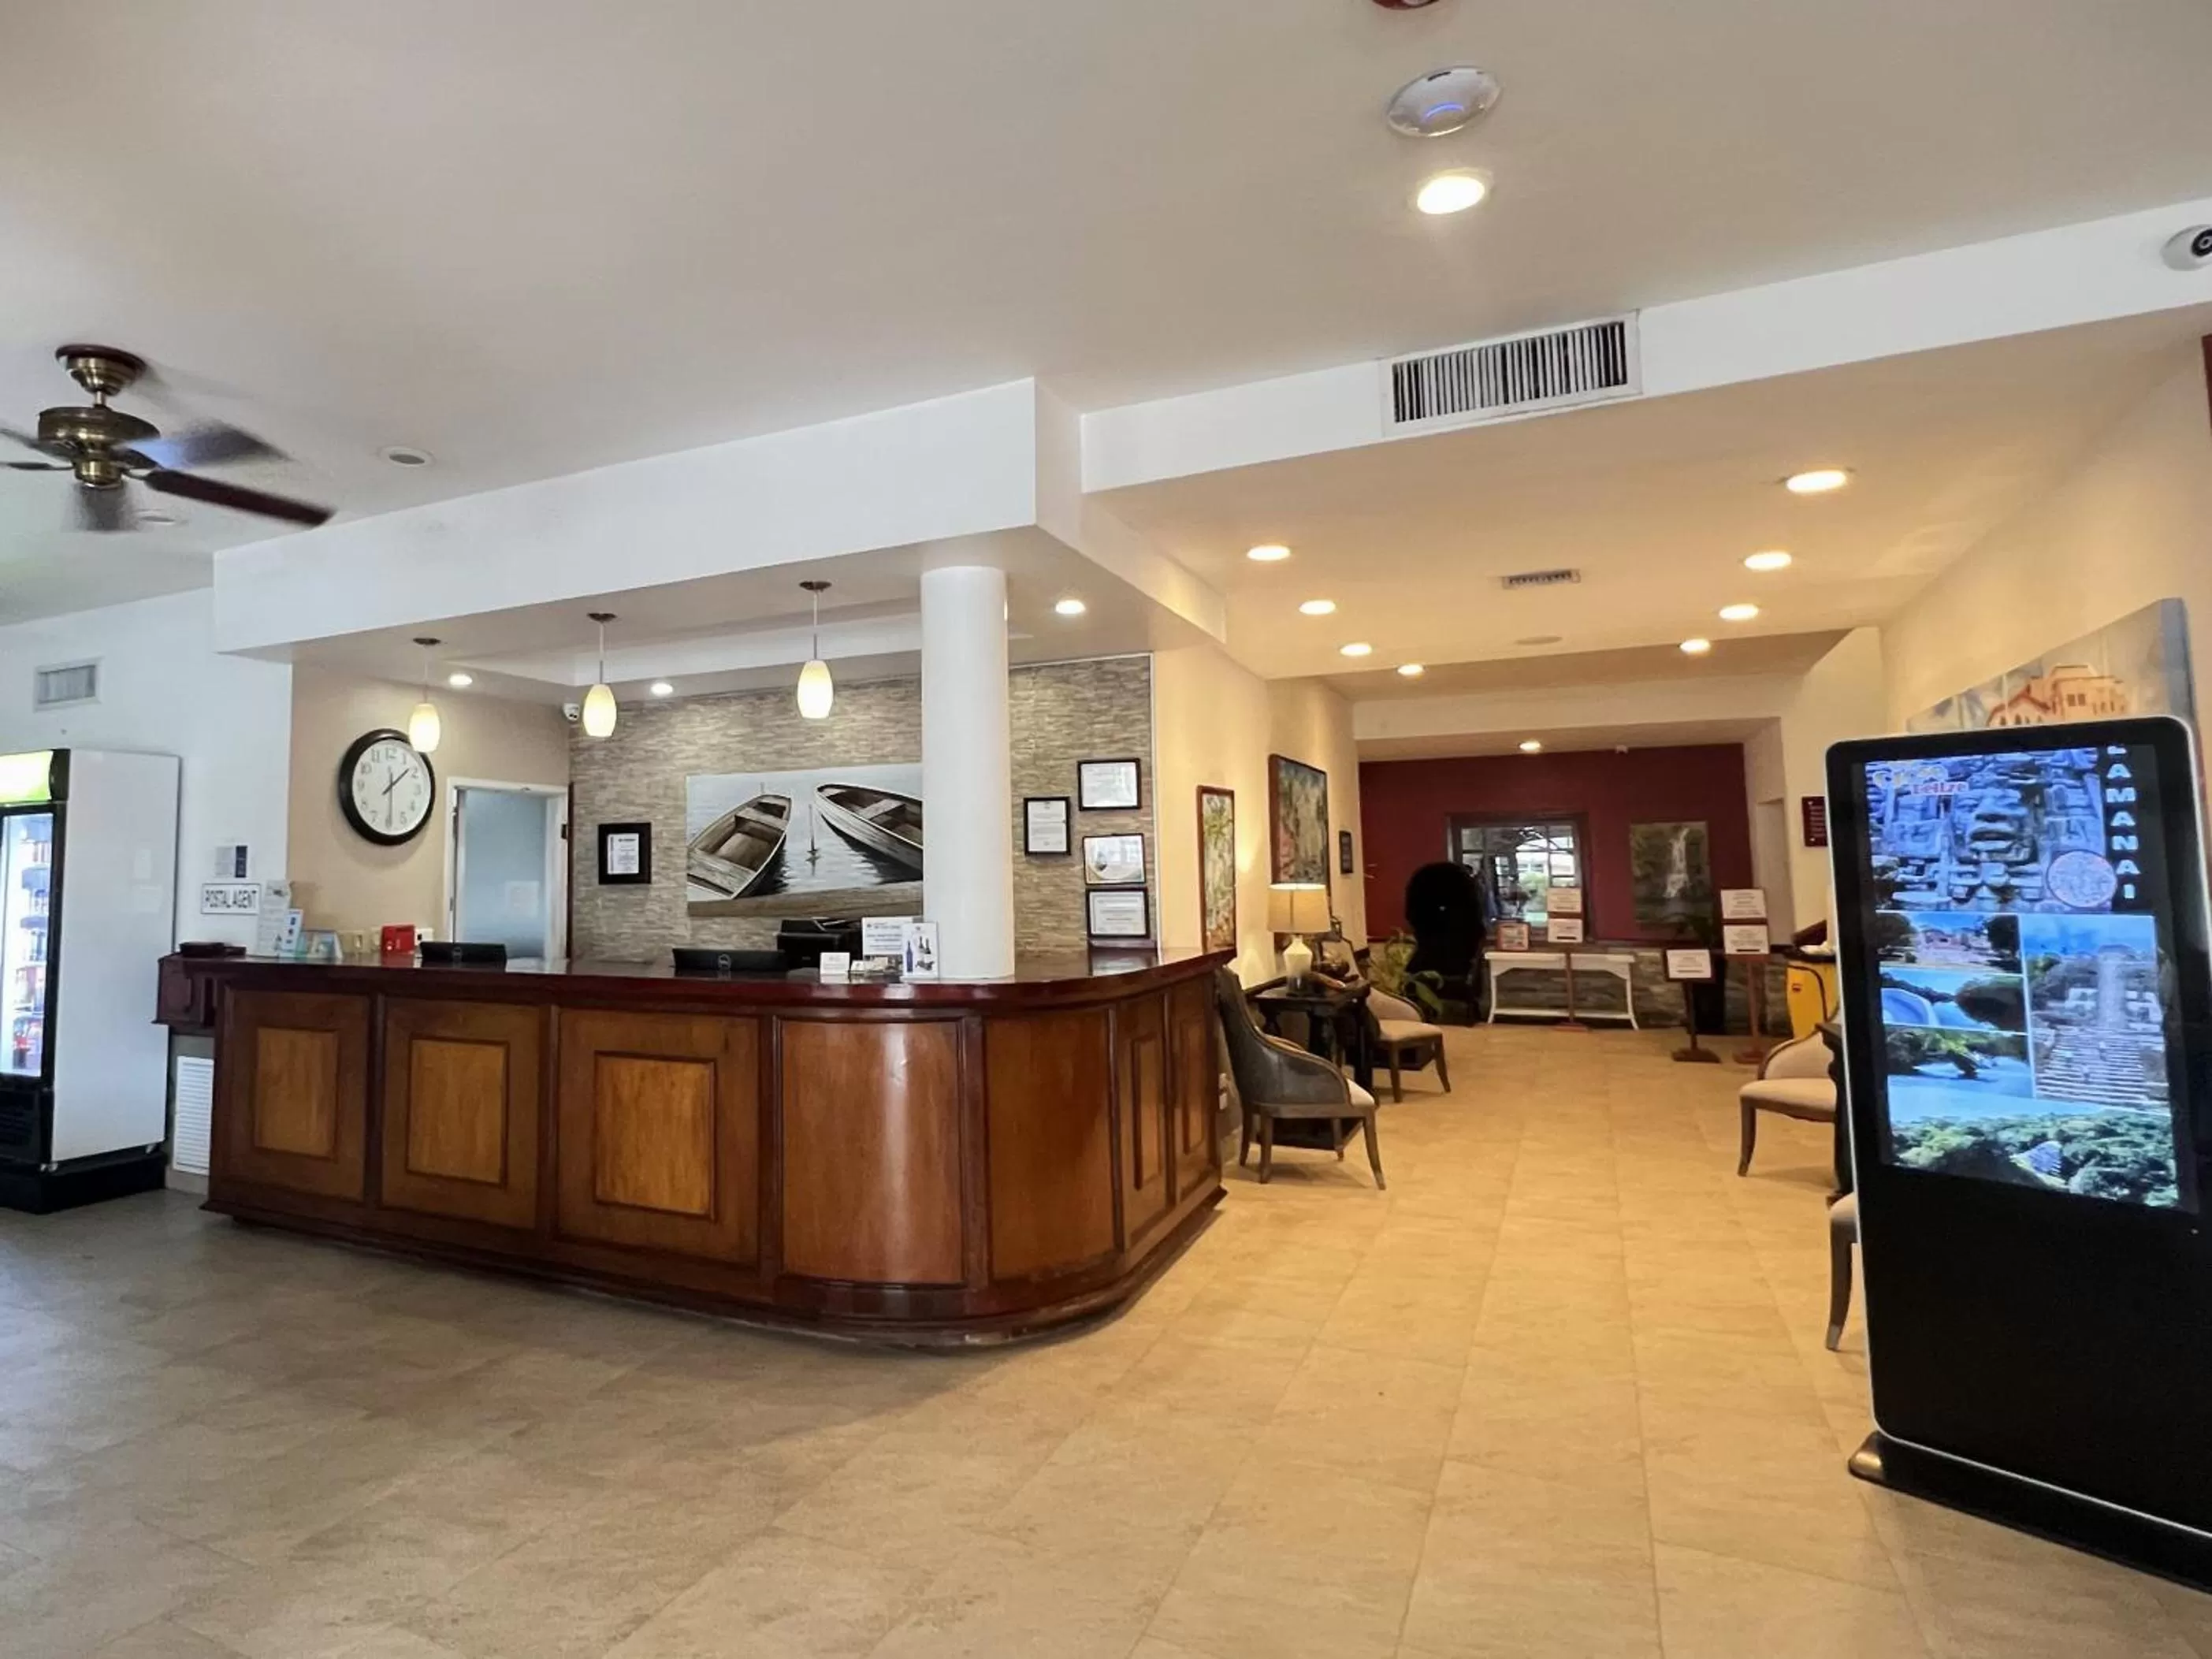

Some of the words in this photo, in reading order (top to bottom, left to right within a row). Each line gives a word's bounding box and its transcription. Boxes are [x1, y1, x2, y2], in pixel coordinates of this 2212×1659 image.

[371, 748, 380, 764] 11
[385, 746, 398, 761] 12
[402, 753, 407, 765] 1
[360, 761, 373, 776] 10
[411, 766, 419, 779] 2
[356, 779, 365, 792] 9
[413, 784, 422, 797] 3
[400, 811, 408, 825] 5
[2106, 746, 2141, 899] LAMANAI
[205, 889, 231, 908] POSTAL
[232, 889, 257, 908] AGENT
